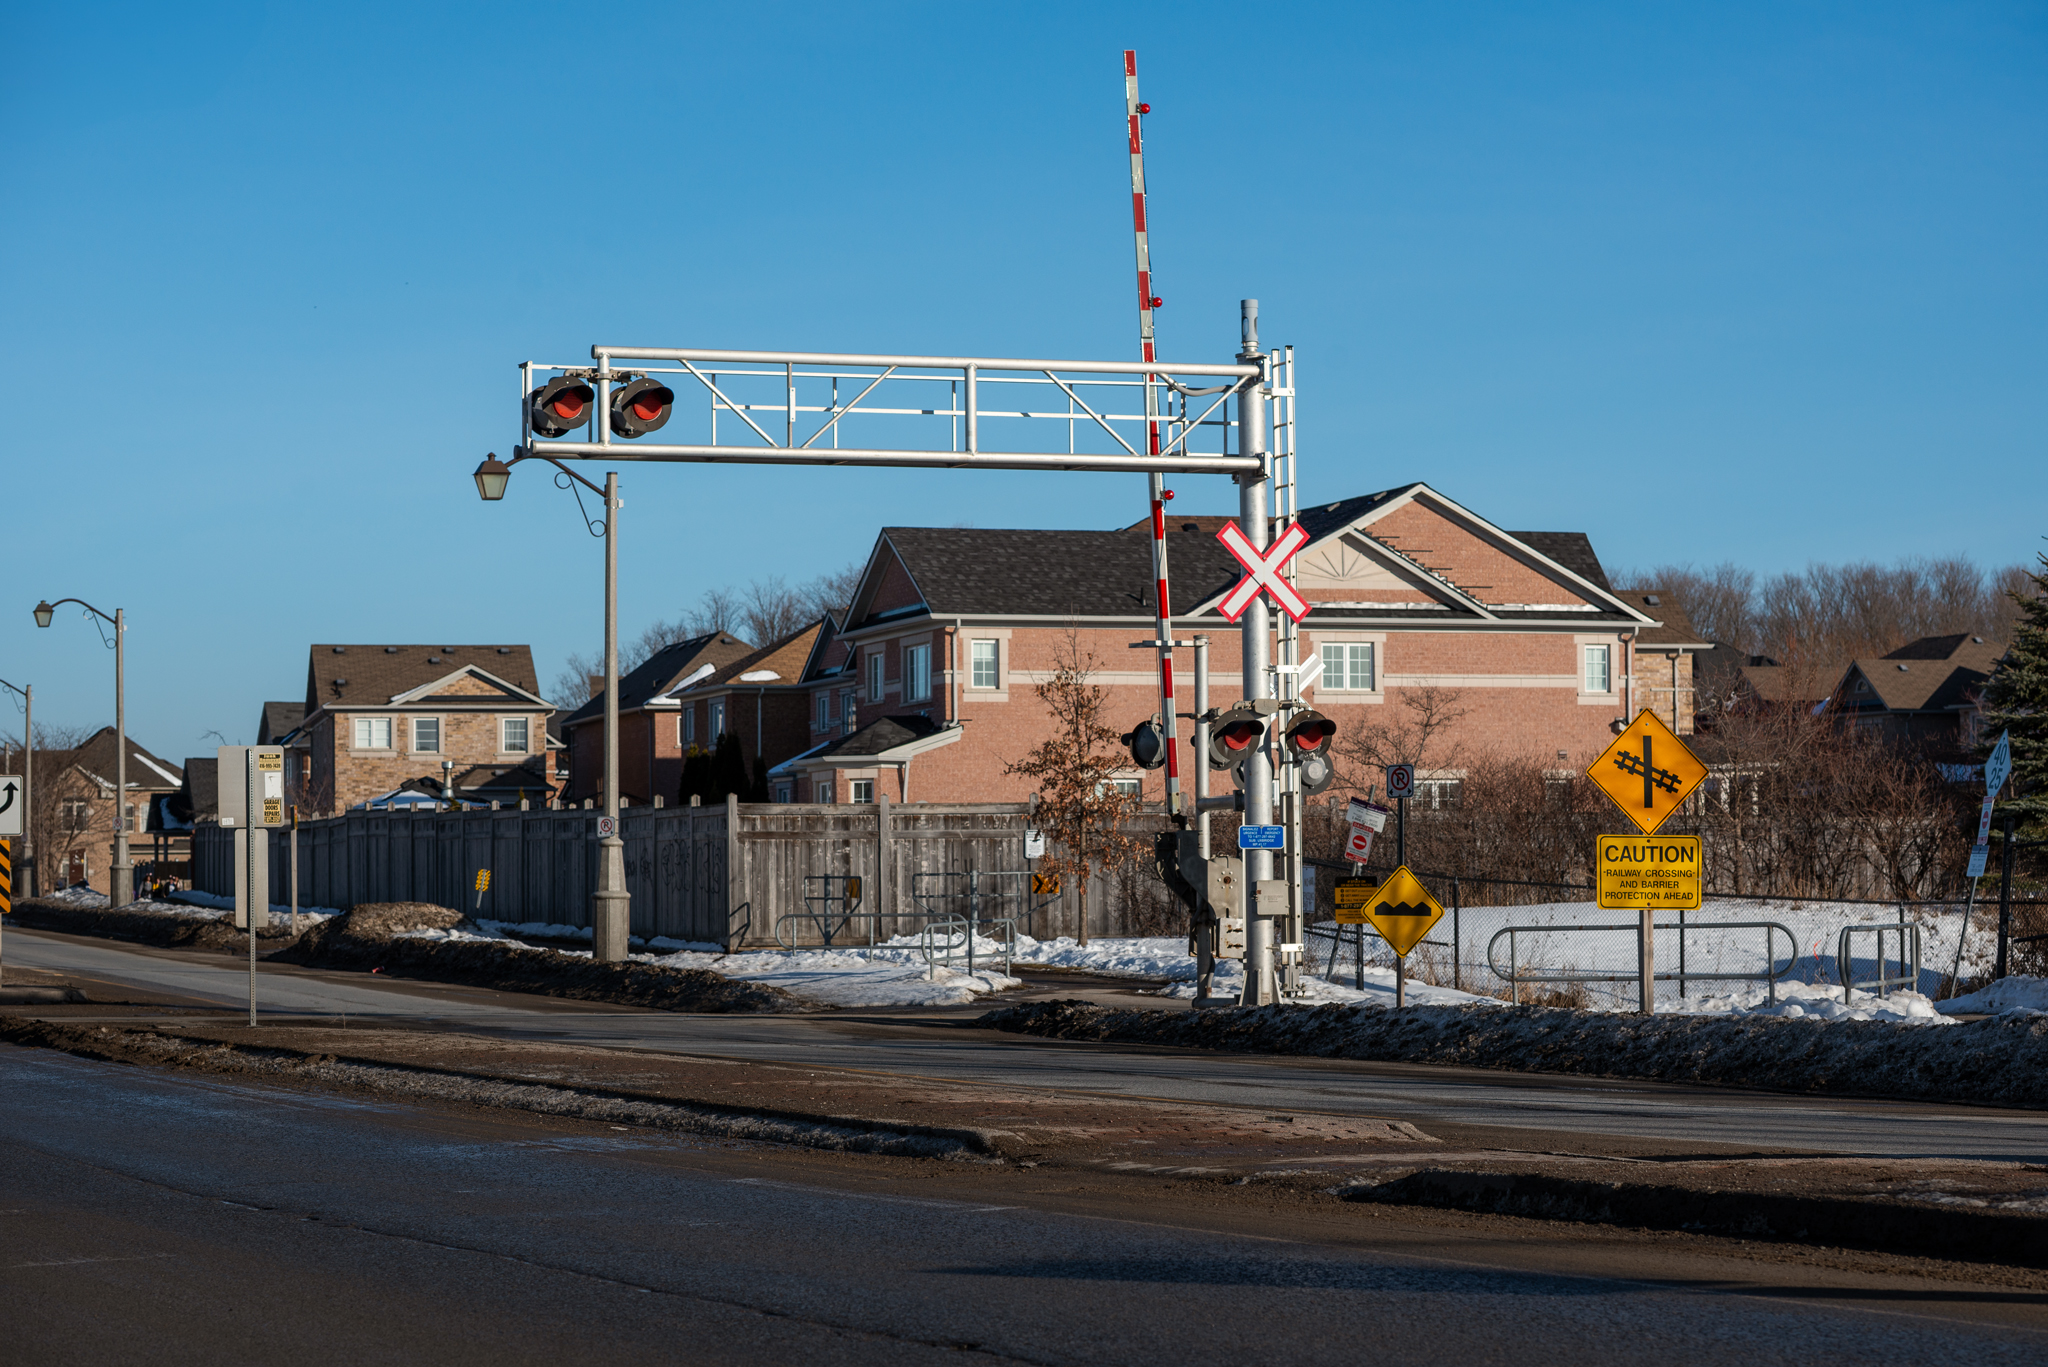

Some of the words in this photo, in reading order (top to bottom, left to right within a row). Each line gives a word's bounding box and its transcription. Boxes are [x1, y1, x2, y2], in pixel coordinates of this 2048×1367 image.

[1994, 743, 2008, 766] 40
[1988, 767, 2003, 790] 25
[1605, 845, 1694, 862] CAUTION
[1606, 869, 1641, 877] RAILWAY
[1645, 869, 1693, 878] CROSSING
[1663, 892, 1693, 900] AHEAD
